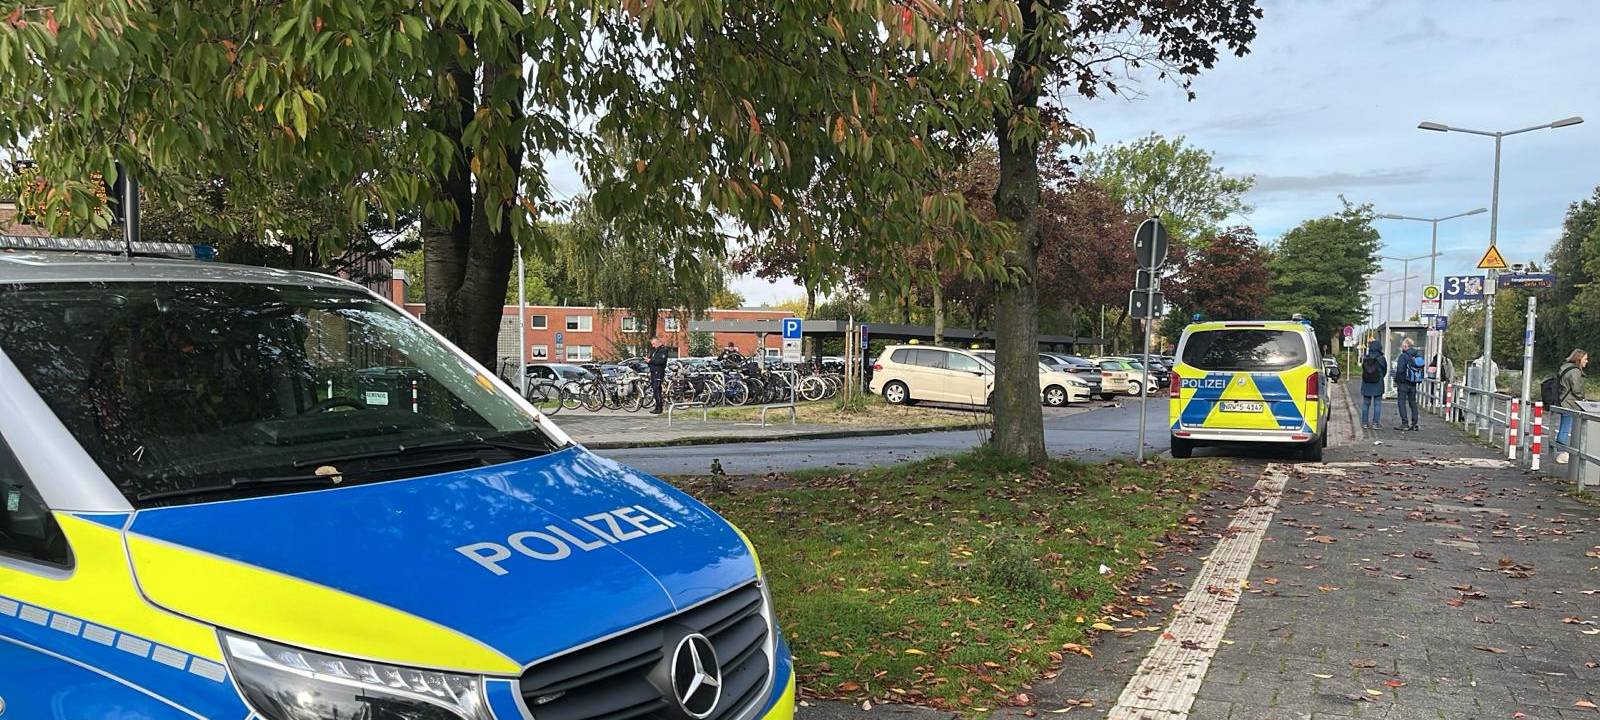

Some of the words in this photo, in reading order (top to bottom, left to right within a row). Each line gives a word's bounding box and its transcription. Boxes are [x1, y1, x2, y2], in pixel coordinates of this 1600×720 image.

[787, 321, 798, 337] P
[1181, 379, 1226, 389] POLIZEI
[454, 504, 678, 576] POLIZEI
